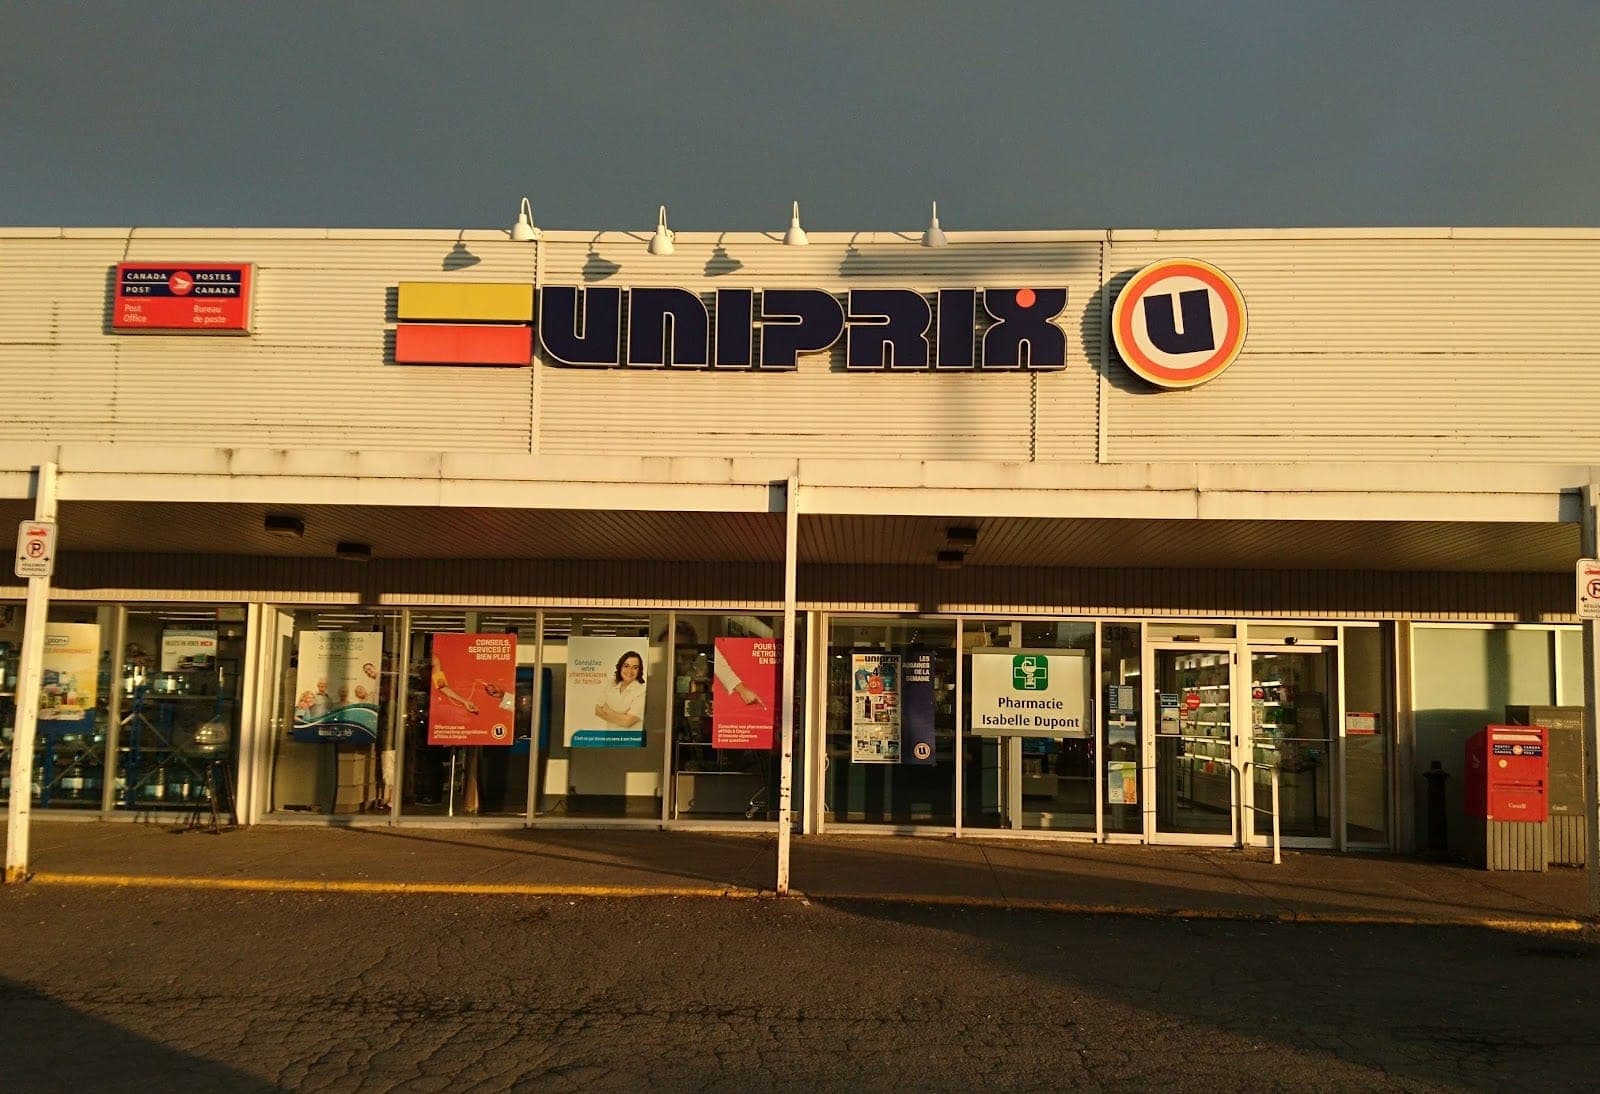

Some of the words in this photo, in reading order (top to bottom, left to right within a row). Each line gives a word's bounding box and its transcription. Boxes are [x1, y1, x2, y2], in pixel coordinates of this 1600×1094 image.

[126, 272, 168, 280] CANADA
[195, 273, 233, 281] POSTES
[194, 286, 236, 294] CANADA
[124, 304, 142, 312] Post
[193, 304, 222, 313] Bureau
[123, 314, 147, 322] Office
[193, 315, 203, 323] de
[204, 316, 226, 325] poste
[539, 284, 1070, 371] UNIPRIX
[753, 643, 774, 651] POUR
[998, 696, 1063, 710] Pharmacie
[982, 713, 1030, 726] Isabelle
[1034, 716, 1080, 730] Dupont
